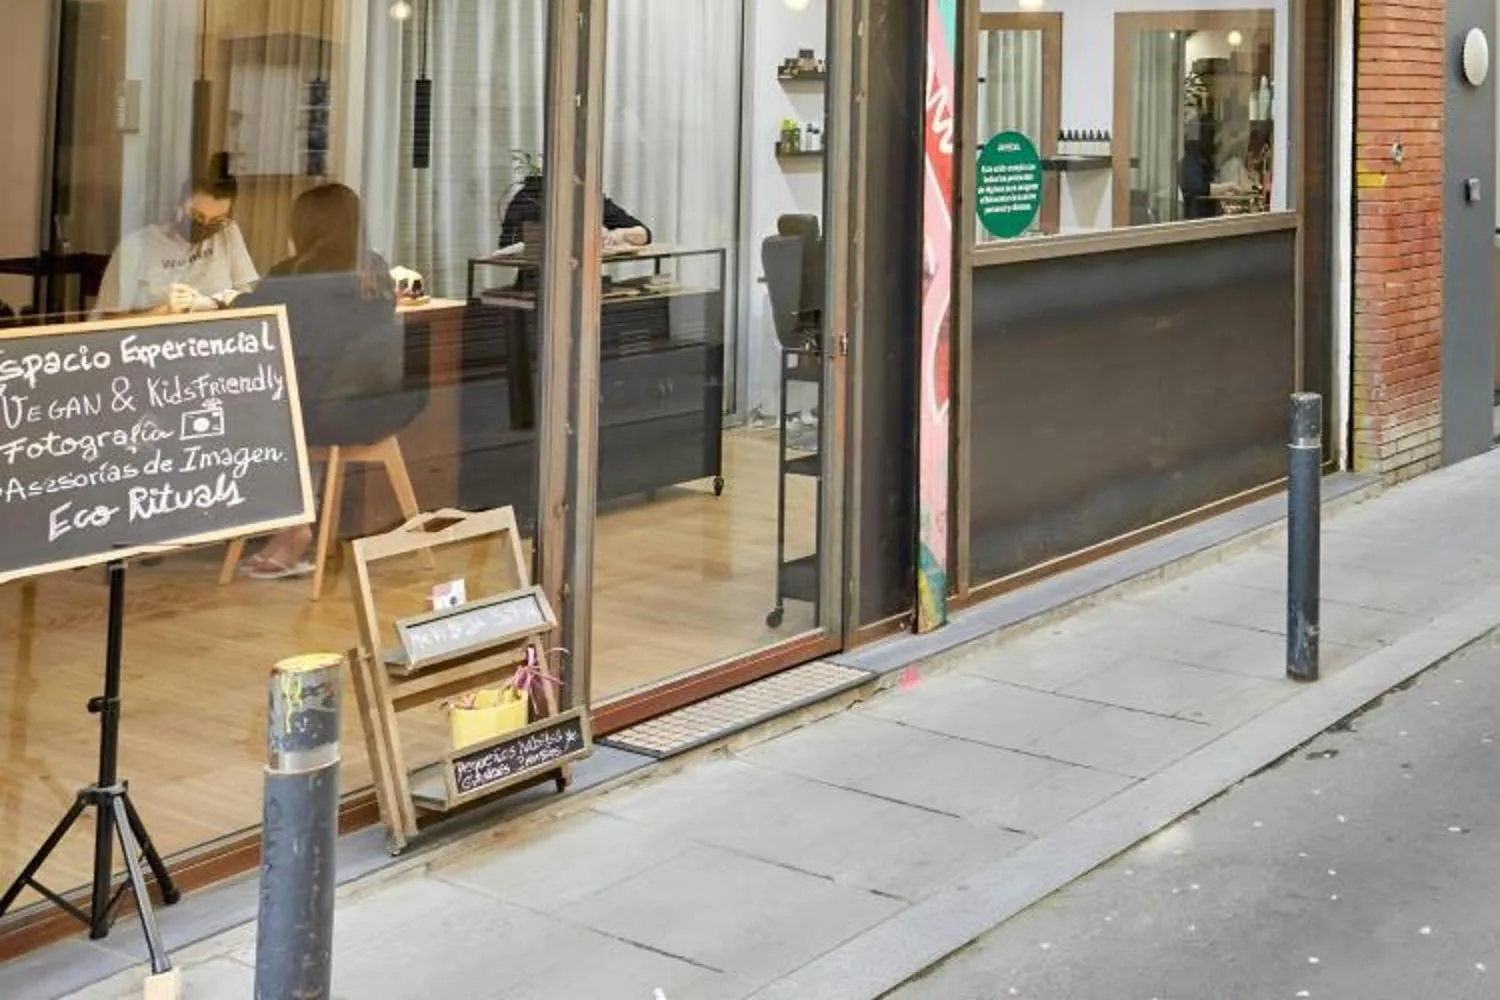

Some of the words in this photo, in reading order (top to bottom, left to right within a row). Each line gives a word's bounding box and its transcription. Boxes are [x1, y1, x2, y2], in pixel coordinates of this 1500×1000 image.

[0, 346, 111, 389] spacio
[120, 321, 275, 368] Experiencial
[111, 375, 136, 413] &
[143, 449, 173, 475] de
[48, 501, 120, 543] Eco
[127, 473, 247, 523] Rituals
